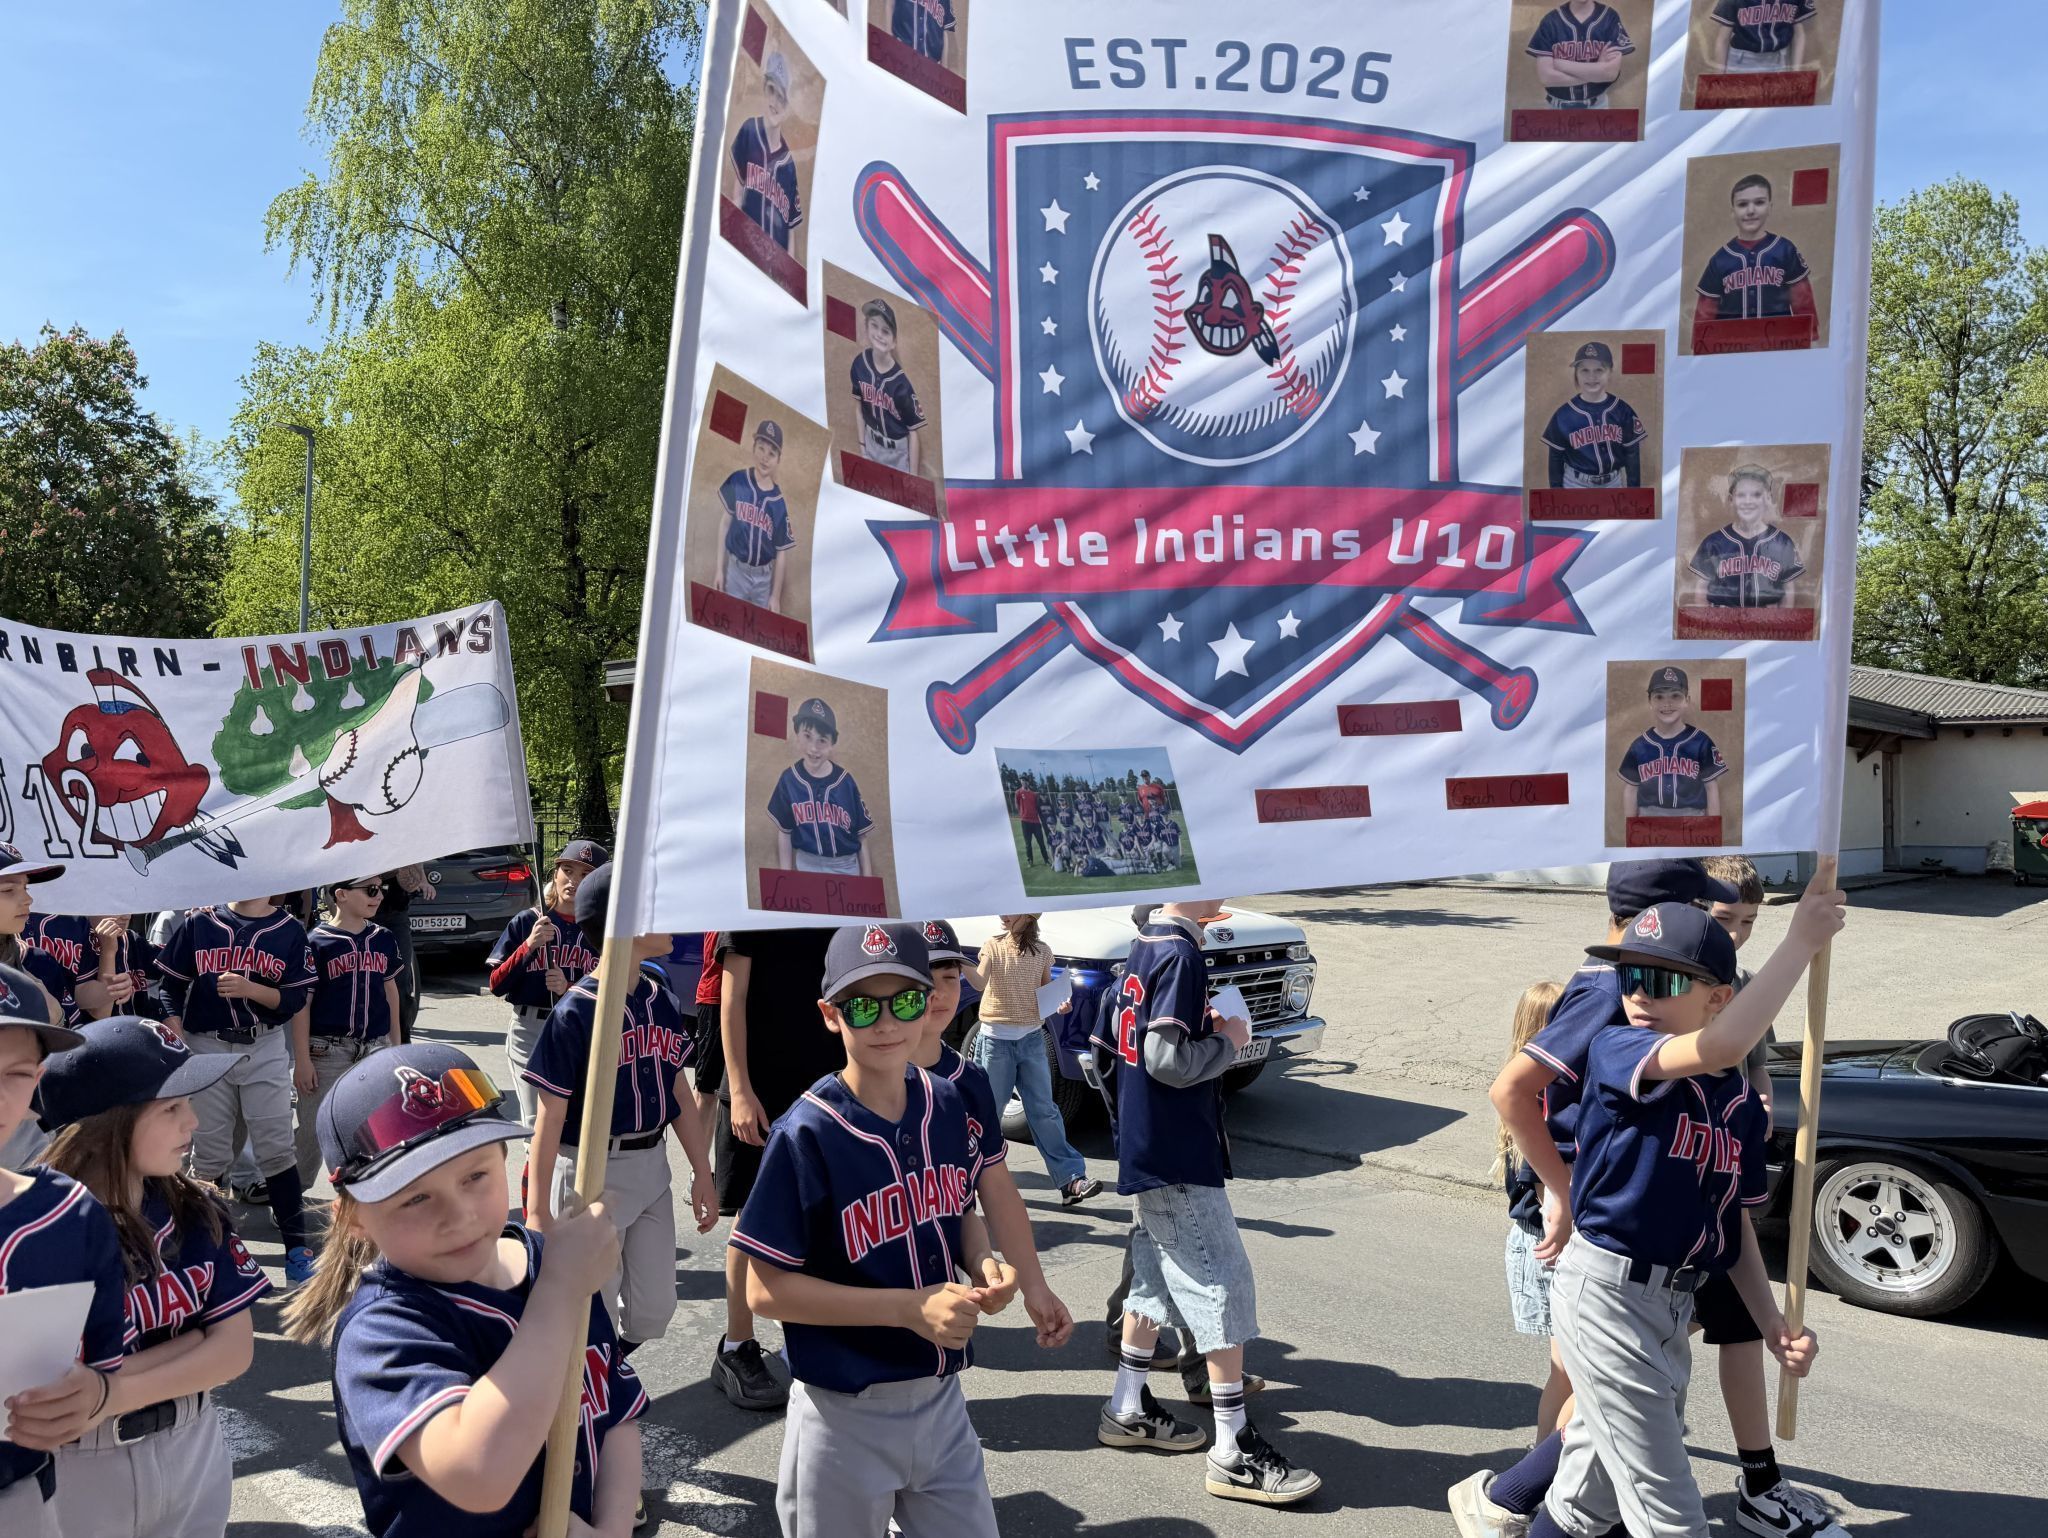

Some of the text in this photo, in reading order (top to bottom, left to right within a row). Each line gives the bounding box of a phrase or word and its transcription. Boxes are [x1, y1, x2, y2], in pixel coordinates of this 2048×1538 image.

[1064, 37, 1392, 104] EST.2026
[1552, 41, 1608, 62] INDIAN
[943, 514, 1516, 572] Little Indians U10
[241, 613, 493, 690] INDIANS
[791, 801, 852, 834] NDIANS
[195, 946, 286, 983] INDIANS
[1204, 951, 1273, 967] ORD
[617, 1023, 683, 1068] DIANS
[841, 1163, 968, 1263] INDIANS
